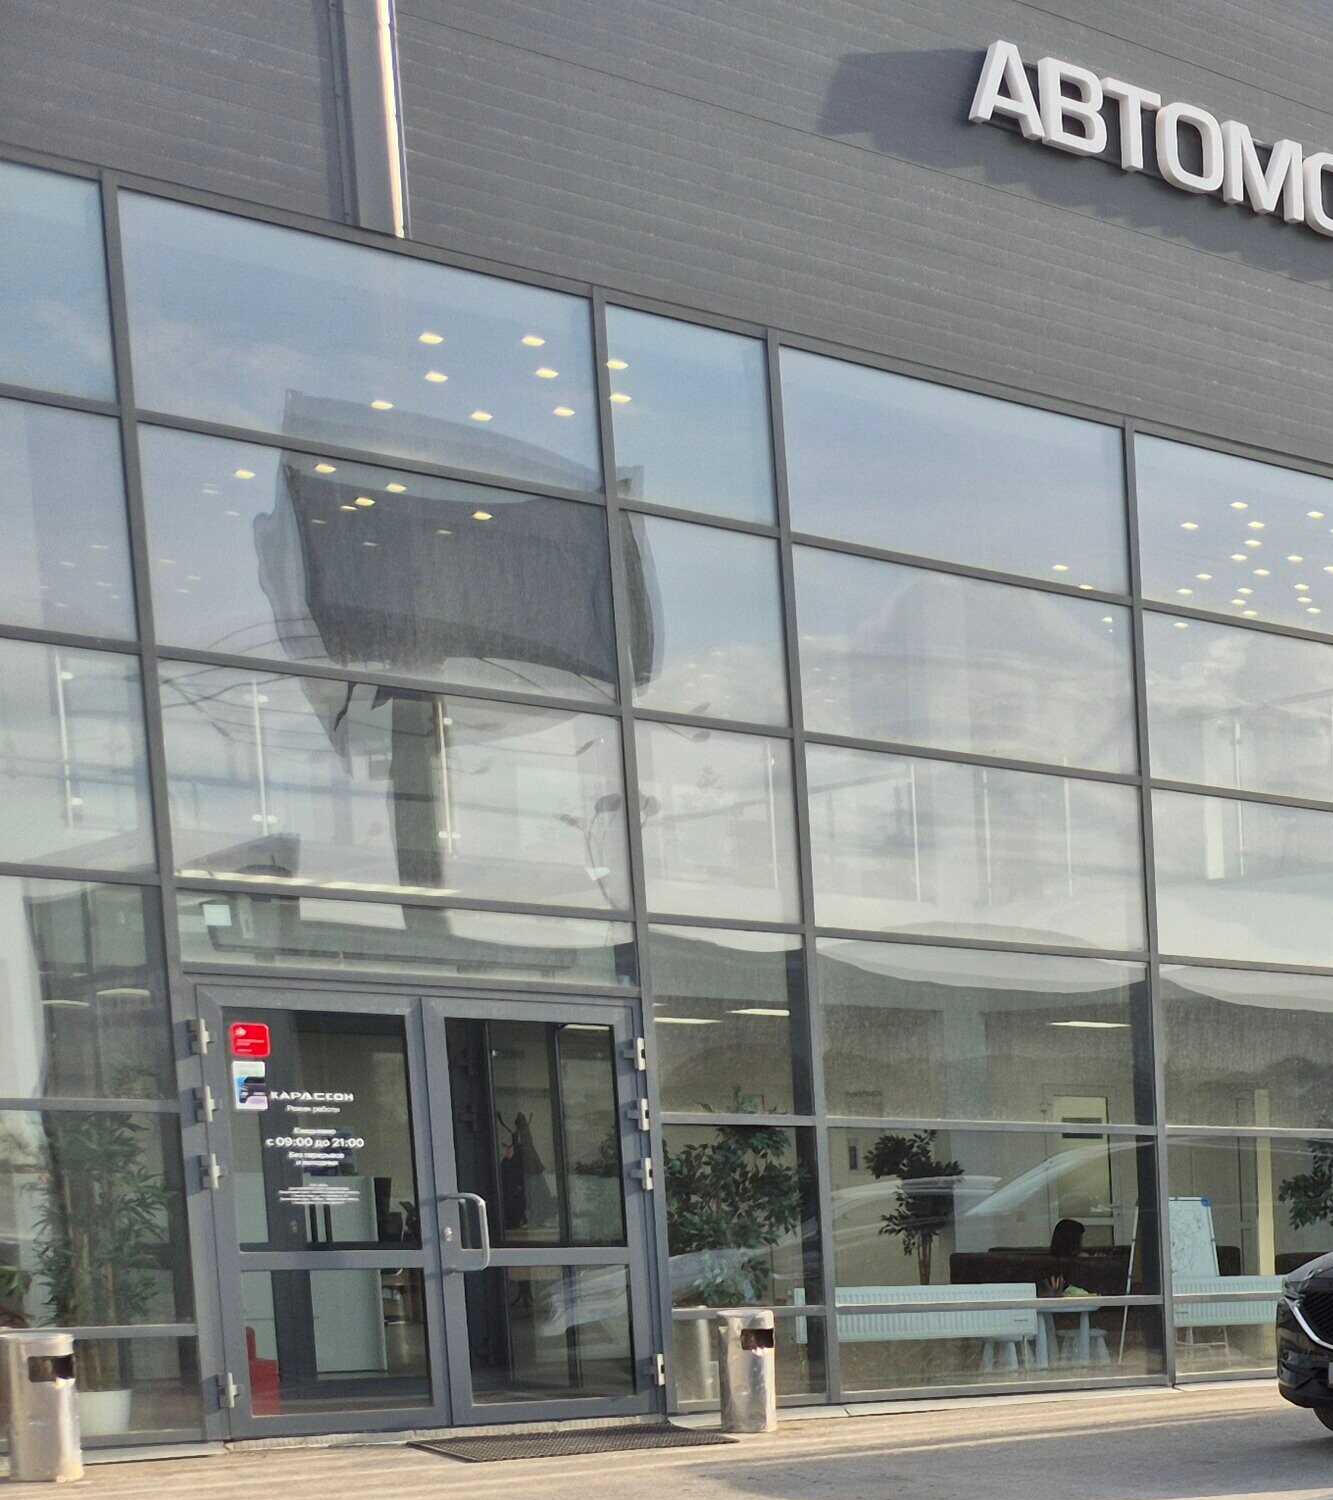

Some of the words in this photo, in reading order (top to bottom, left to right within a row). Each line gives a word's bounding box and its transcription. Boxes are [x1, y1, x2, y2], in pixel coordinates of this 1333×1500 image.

[269, 1090, 354, 1102] КАРАССОН
[275, 1137, 313, 1147] 09:00
[314, 1138, 330, 1148] до
[332, 1138, 365, 1148] 21:00
